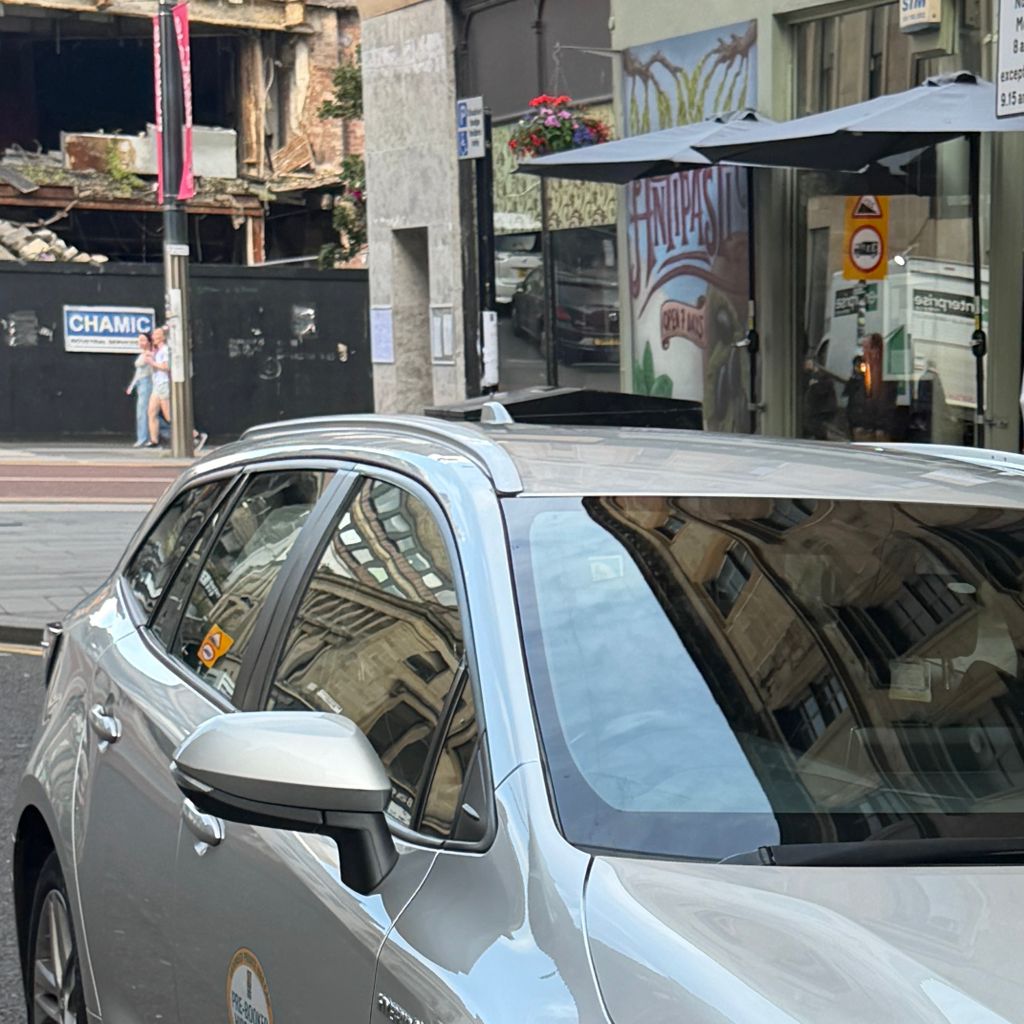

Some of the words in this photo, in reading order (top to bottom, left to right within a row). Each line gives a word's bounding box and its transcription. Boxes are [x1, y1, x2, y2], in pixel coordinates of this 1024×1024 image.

[1013, 38, 1019, 54] 8
[1001, 91, 1016, 107] 9.15
[69, 314, 151, 334] CHAMIC
